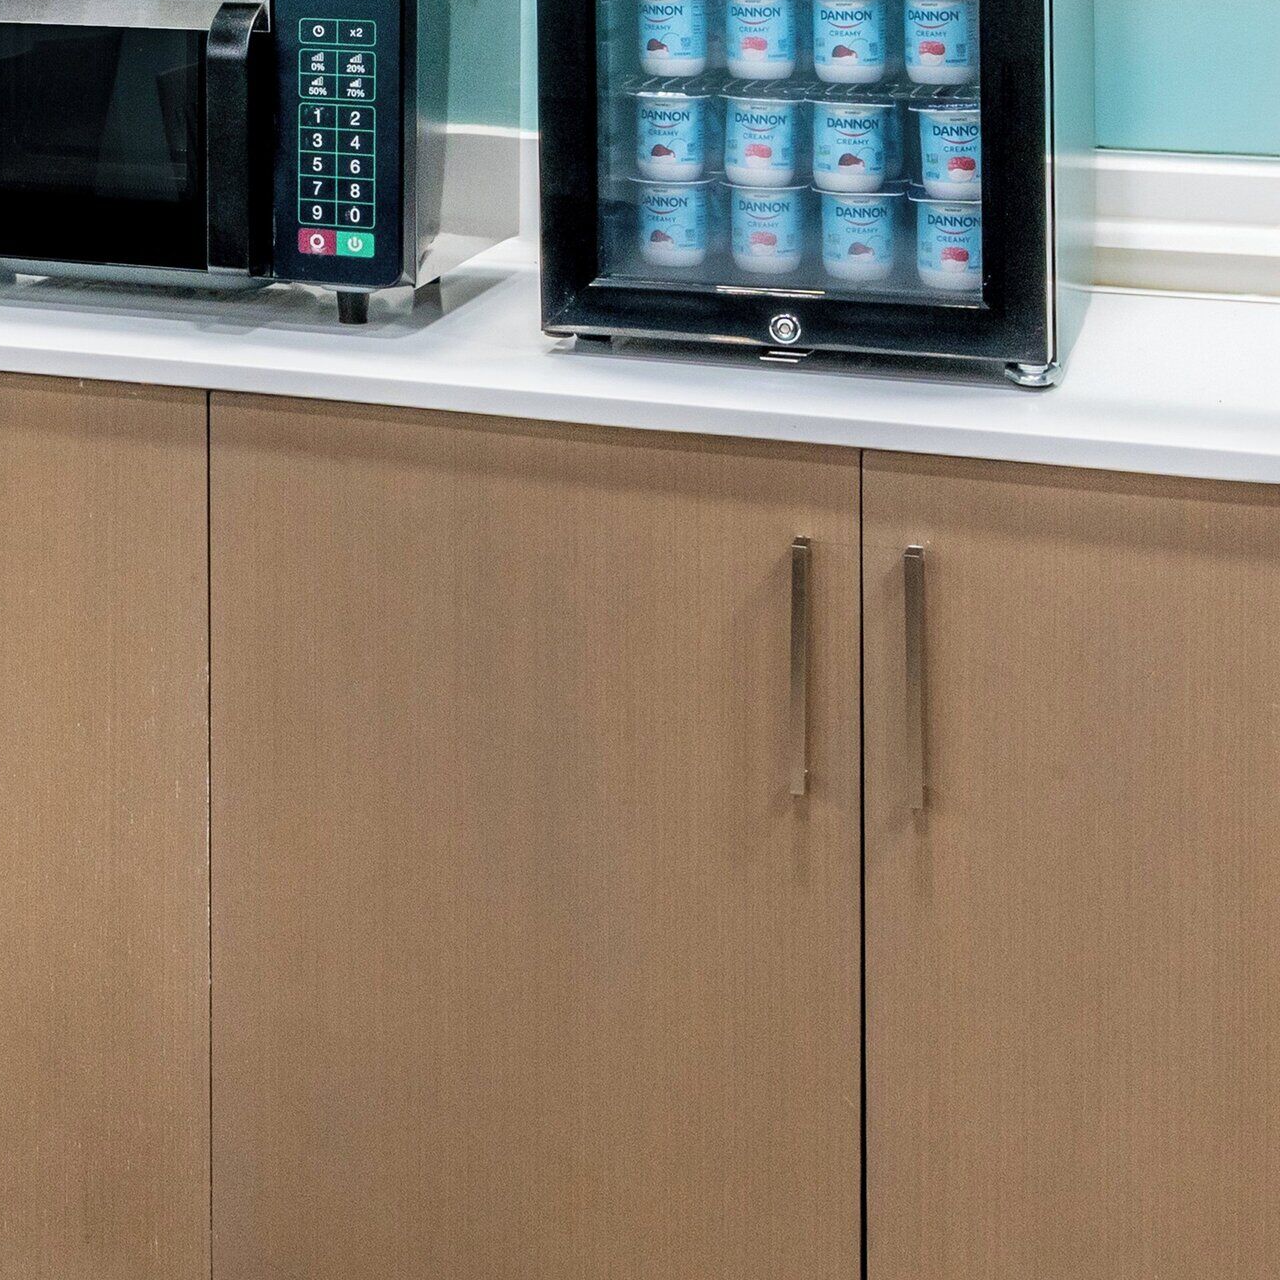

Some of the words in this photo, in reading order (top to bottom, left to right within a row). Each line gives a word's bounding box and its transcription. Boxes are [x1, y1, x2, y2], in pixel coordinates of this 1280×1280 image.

[731, 6, 781, 17] DANNON
[820, 10, 873, 21] DANNON
[908, 10, 960, 21] DANNON
[349, 27, 363, 37] x2
[310, 62, 325, 72] 0%
[346, 64, 365, 74] 20%
[308, 86, 327, 96] 50%
[346, 88, 365, 98] 70%
[313, 109, 321, 124] 1
[350, 111, 361, 126] 2
[641, 109, 690, 121] DANNON
[735, 112, 787, 126] DANNON
[826, 117, 879, 130] DANNON
[932, 125, 980, 137] DANNO
[312, 133, 323, 148] 3
[350, 135, 361, 150] 4
[312, 157, 323, 172] 5
[350, 159, 361, 174] 6
[312, 181, 323, 196] 7
[350, 183, 361, 199] 8
[312, 205, 323, 220] 9
[739, 201, 790, 213] DANNON
[836, 207, 888, 219] DANNON
[349, 207, 361, 223] 0
[928, 214, 981, 228] DANNON
